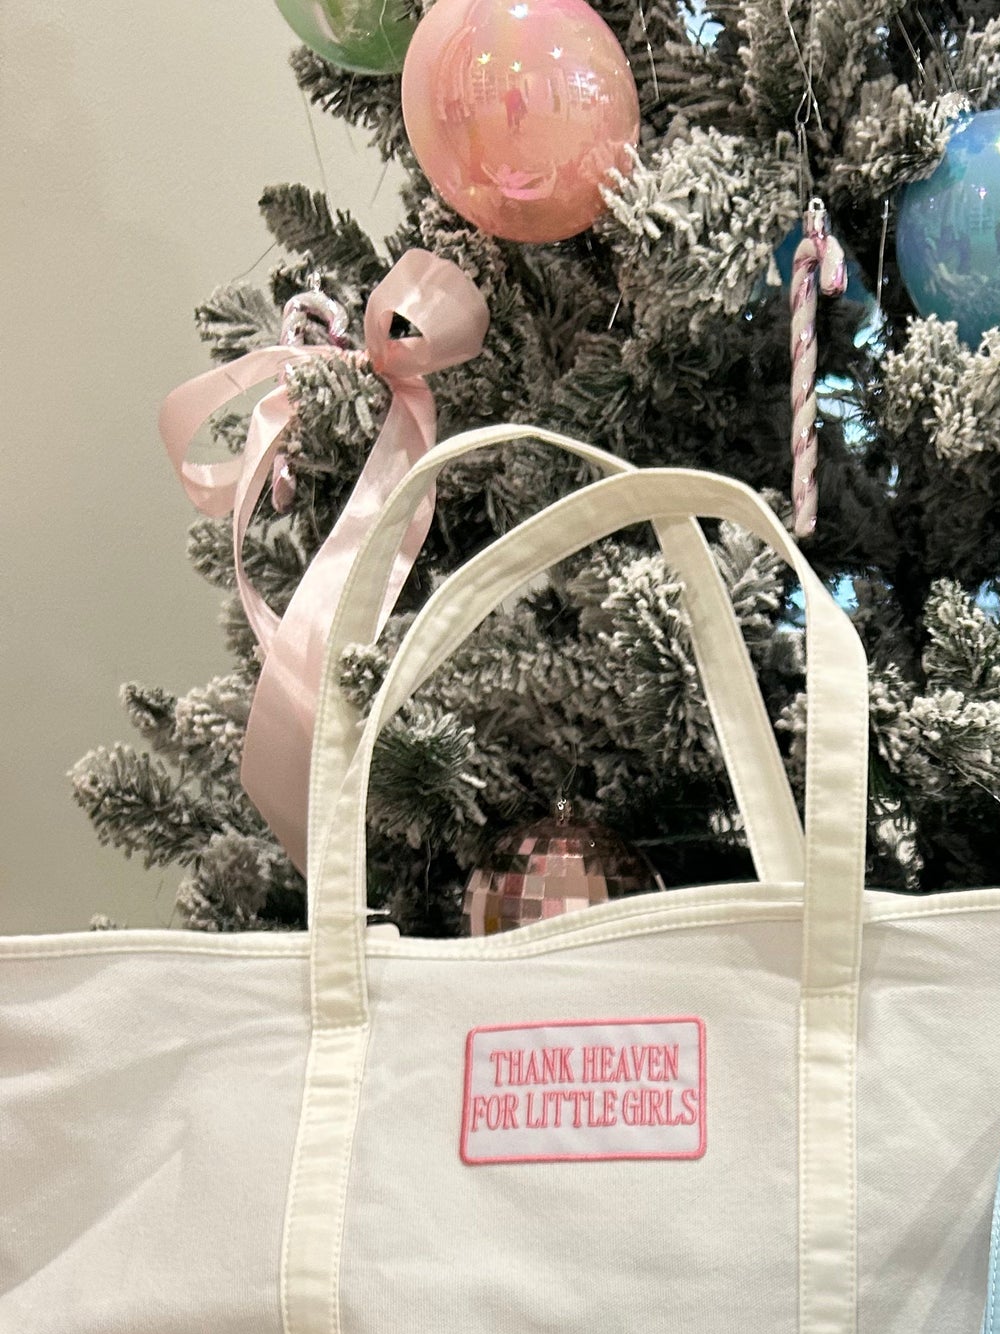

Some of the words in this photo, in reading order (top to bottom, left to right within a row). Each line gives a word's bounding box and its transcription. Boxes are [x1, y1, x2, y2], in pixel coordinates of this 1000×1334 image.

[489, 1047, 574, 1086] THANK
[582, 1043, 679, 1083] HEAVEN
[471, 1094, 518, 1132] FOR
[526, 1089, 617, 1129] LITTLE
[622, 1088, 698, 1127] GIRLS
